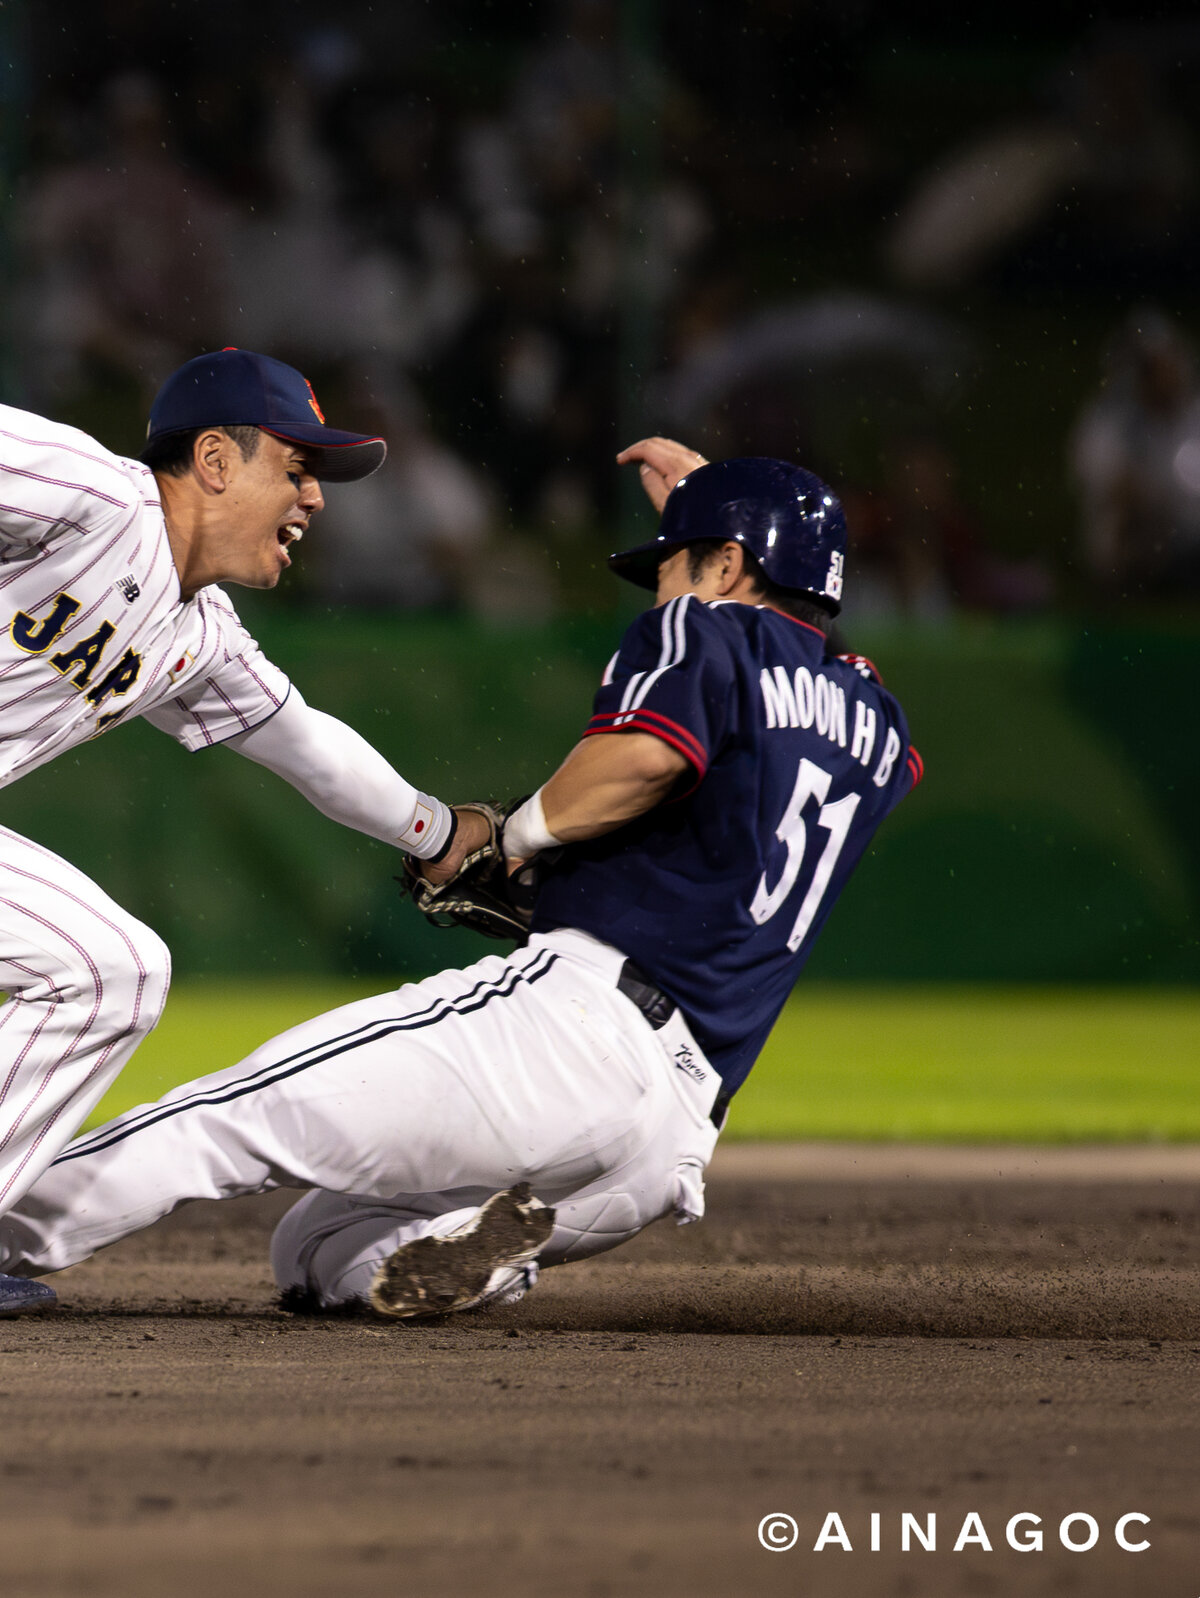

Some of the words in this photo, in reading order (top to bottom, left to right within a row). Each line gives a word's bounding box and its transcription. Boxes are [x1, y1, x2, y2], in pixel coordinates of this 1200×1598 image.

[10, 591, 142, 740] JAP
[759, 665, 847, 748] MOON
[850, 699, 877, 767] H
[872, 726, 901, 788] B
[749, 757, 862, 954] 51
